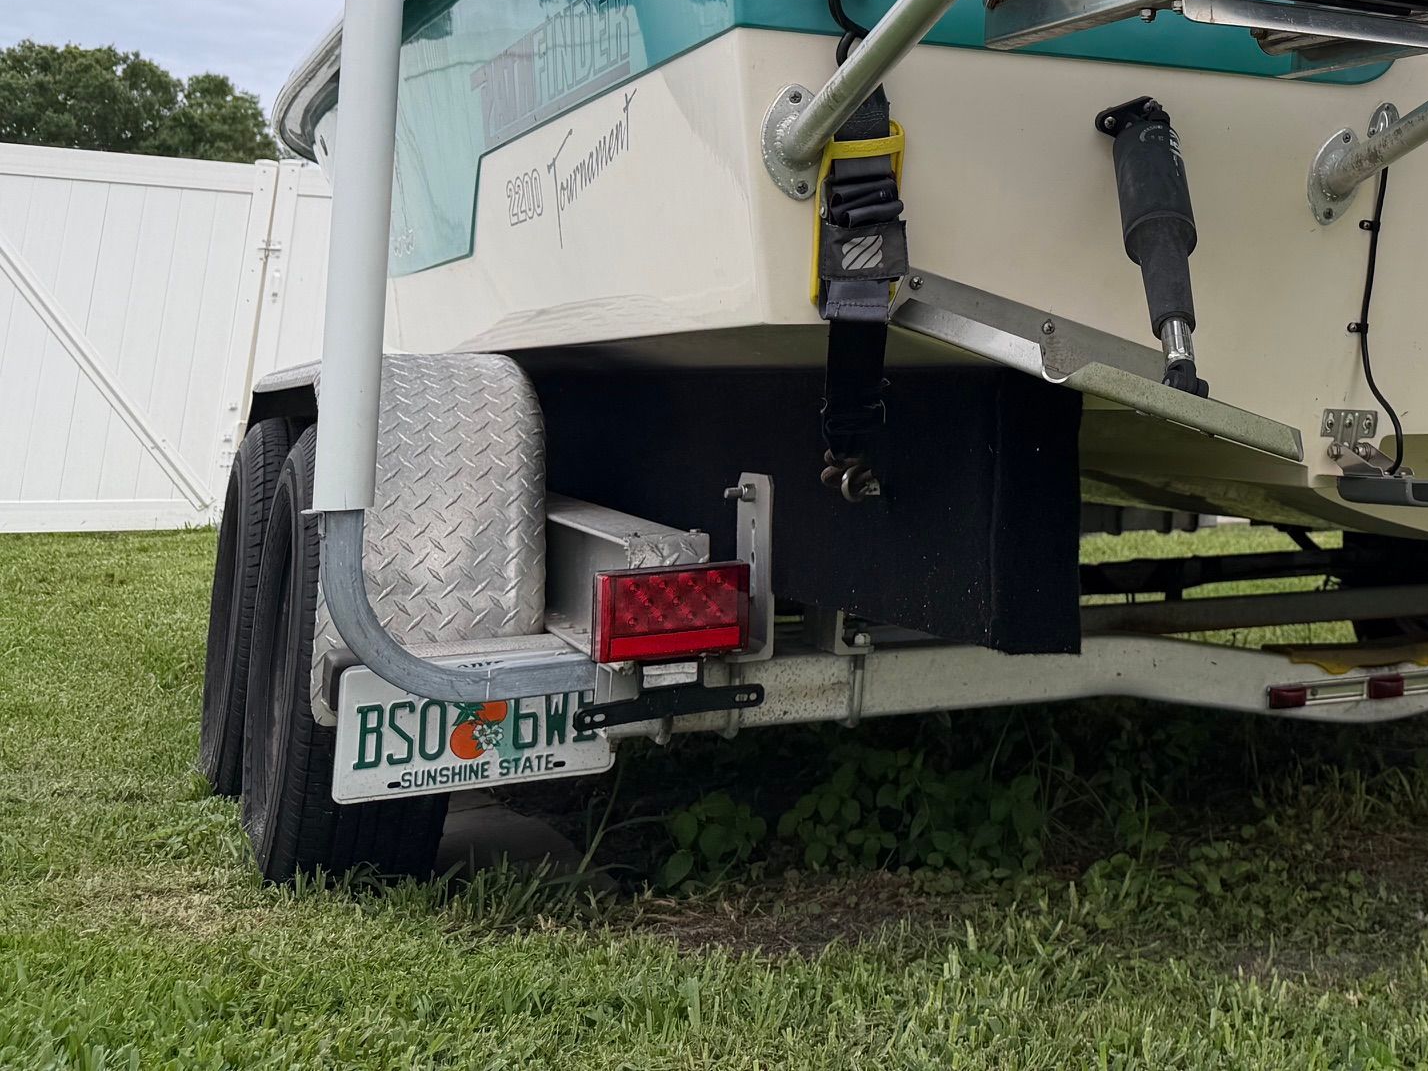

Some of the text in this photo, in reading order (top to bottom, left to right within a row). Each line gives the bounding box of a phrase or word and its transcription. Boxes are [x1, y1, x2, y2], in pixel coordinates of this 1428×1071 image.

[505, 88, 637, 249] 2200 Tournament
[401, 753, 554, 789] SUNSHINE STATE
